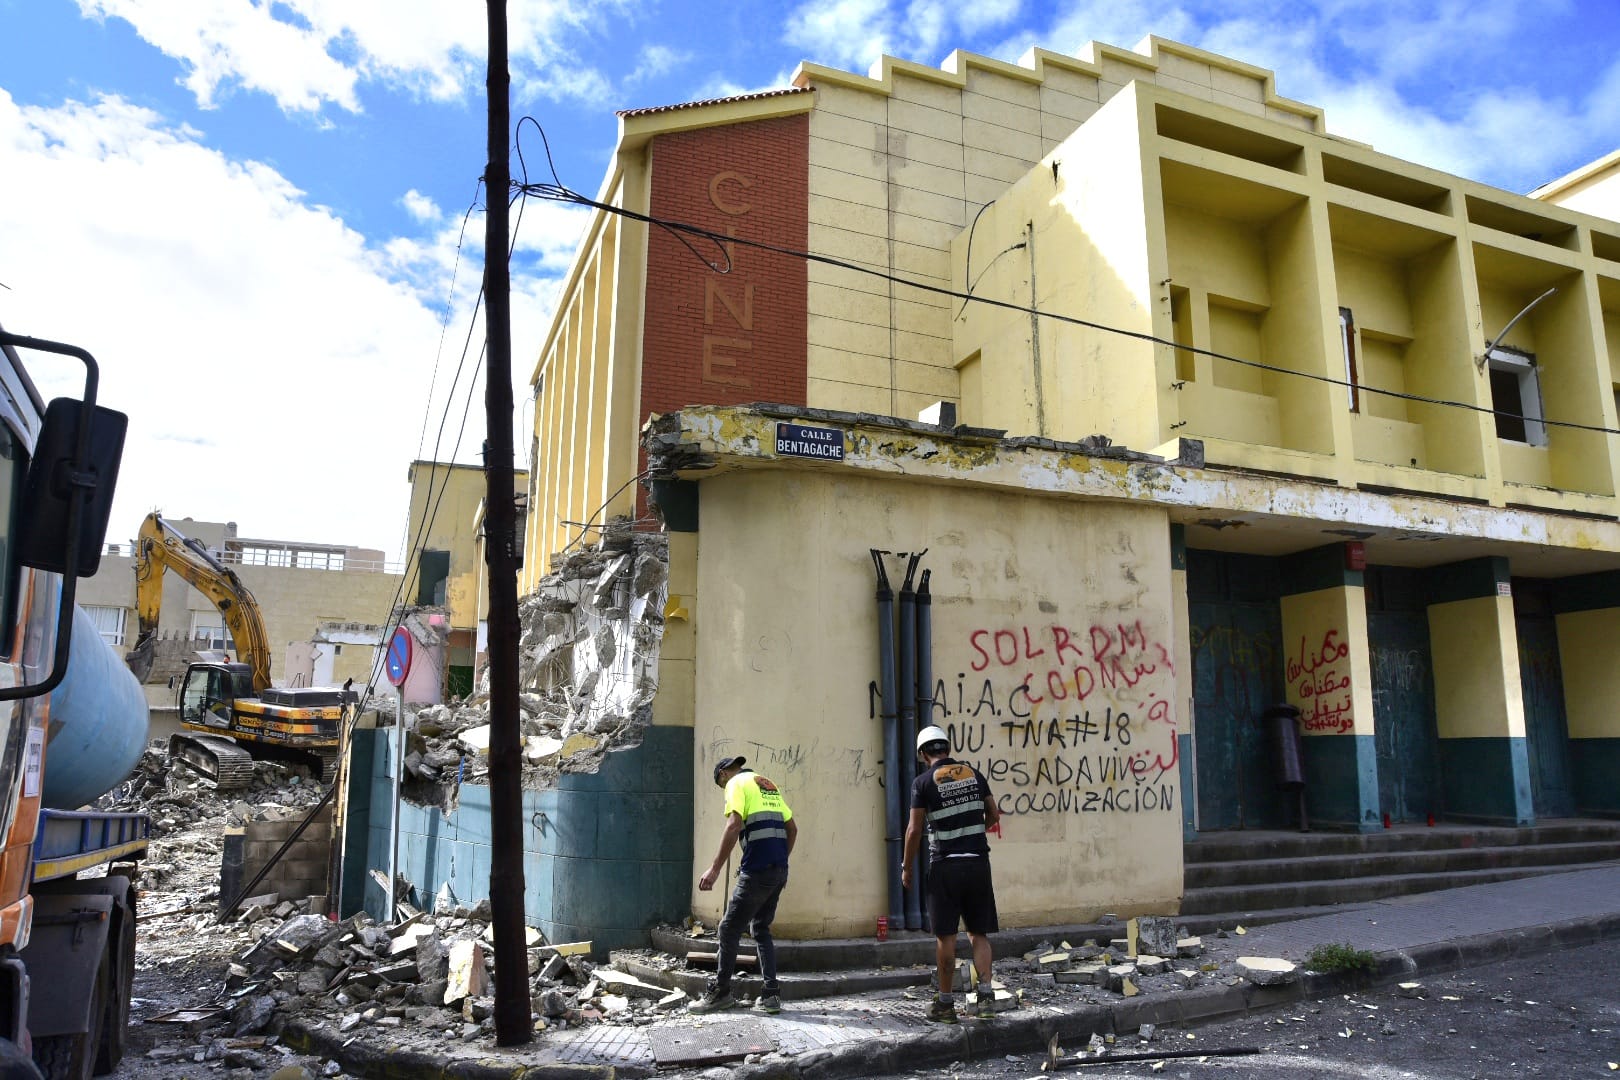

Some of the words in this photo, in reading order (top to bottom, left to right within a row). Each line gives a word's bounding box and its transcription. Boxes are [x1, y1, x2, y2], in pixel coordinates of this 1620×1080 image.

[702, 170, 754, 389] CINE
[800, 429, 833, 441] CALLE
[777, 440, 842, 458] BENTAGACHE
